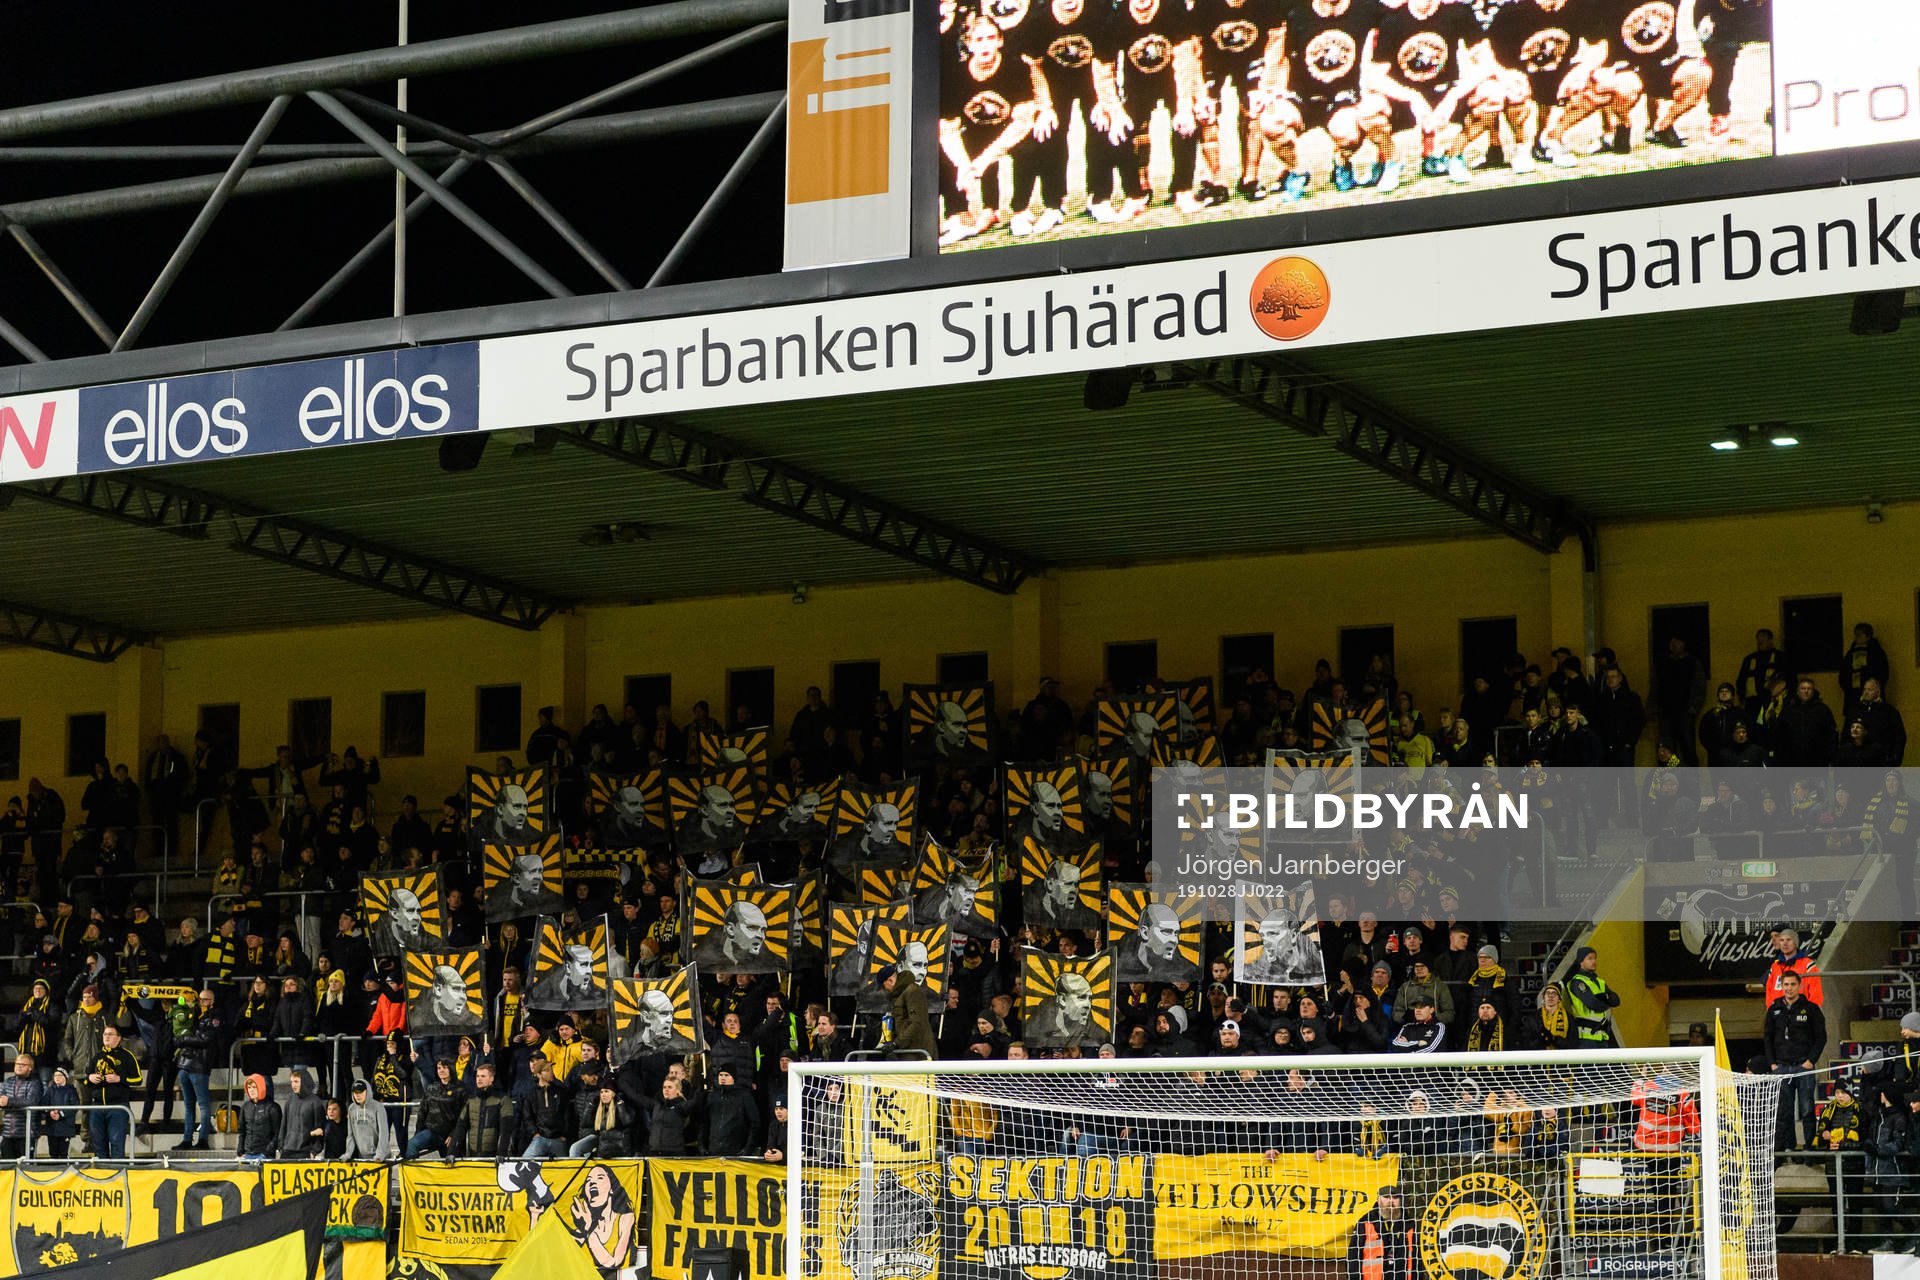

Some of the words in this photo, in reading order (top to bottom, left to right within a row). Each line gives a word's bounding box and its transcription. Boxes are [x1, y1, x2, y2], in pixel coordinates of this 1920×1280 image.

[1785, 66, 1920, 133] Pro
[567, 315, 917, 411] Sparbanken
[943, 270, 1228, 375] Sjuhärad
[299, 358, 451, 444] ellos
[105, 383, 249, 465] ellos
[270, 1162, 381, 1196] PLASTGRÄS?
[947, 1154, 1147, 1203] SEKTION
[1241, 1166, 1273, 1178] THE
[19, 1189, 124, 1208] GULIGANERNA
[414, 1191, 514, 1212] GULSVARTA
[424, 1213, 506, 1234] SYSTRAR
[445, 1236, 469, 1245] SEDAN
[984, 1245, 1036, 1268] ULTRAS
[1040, 1245, 1108, 1270] ELFSBORG
